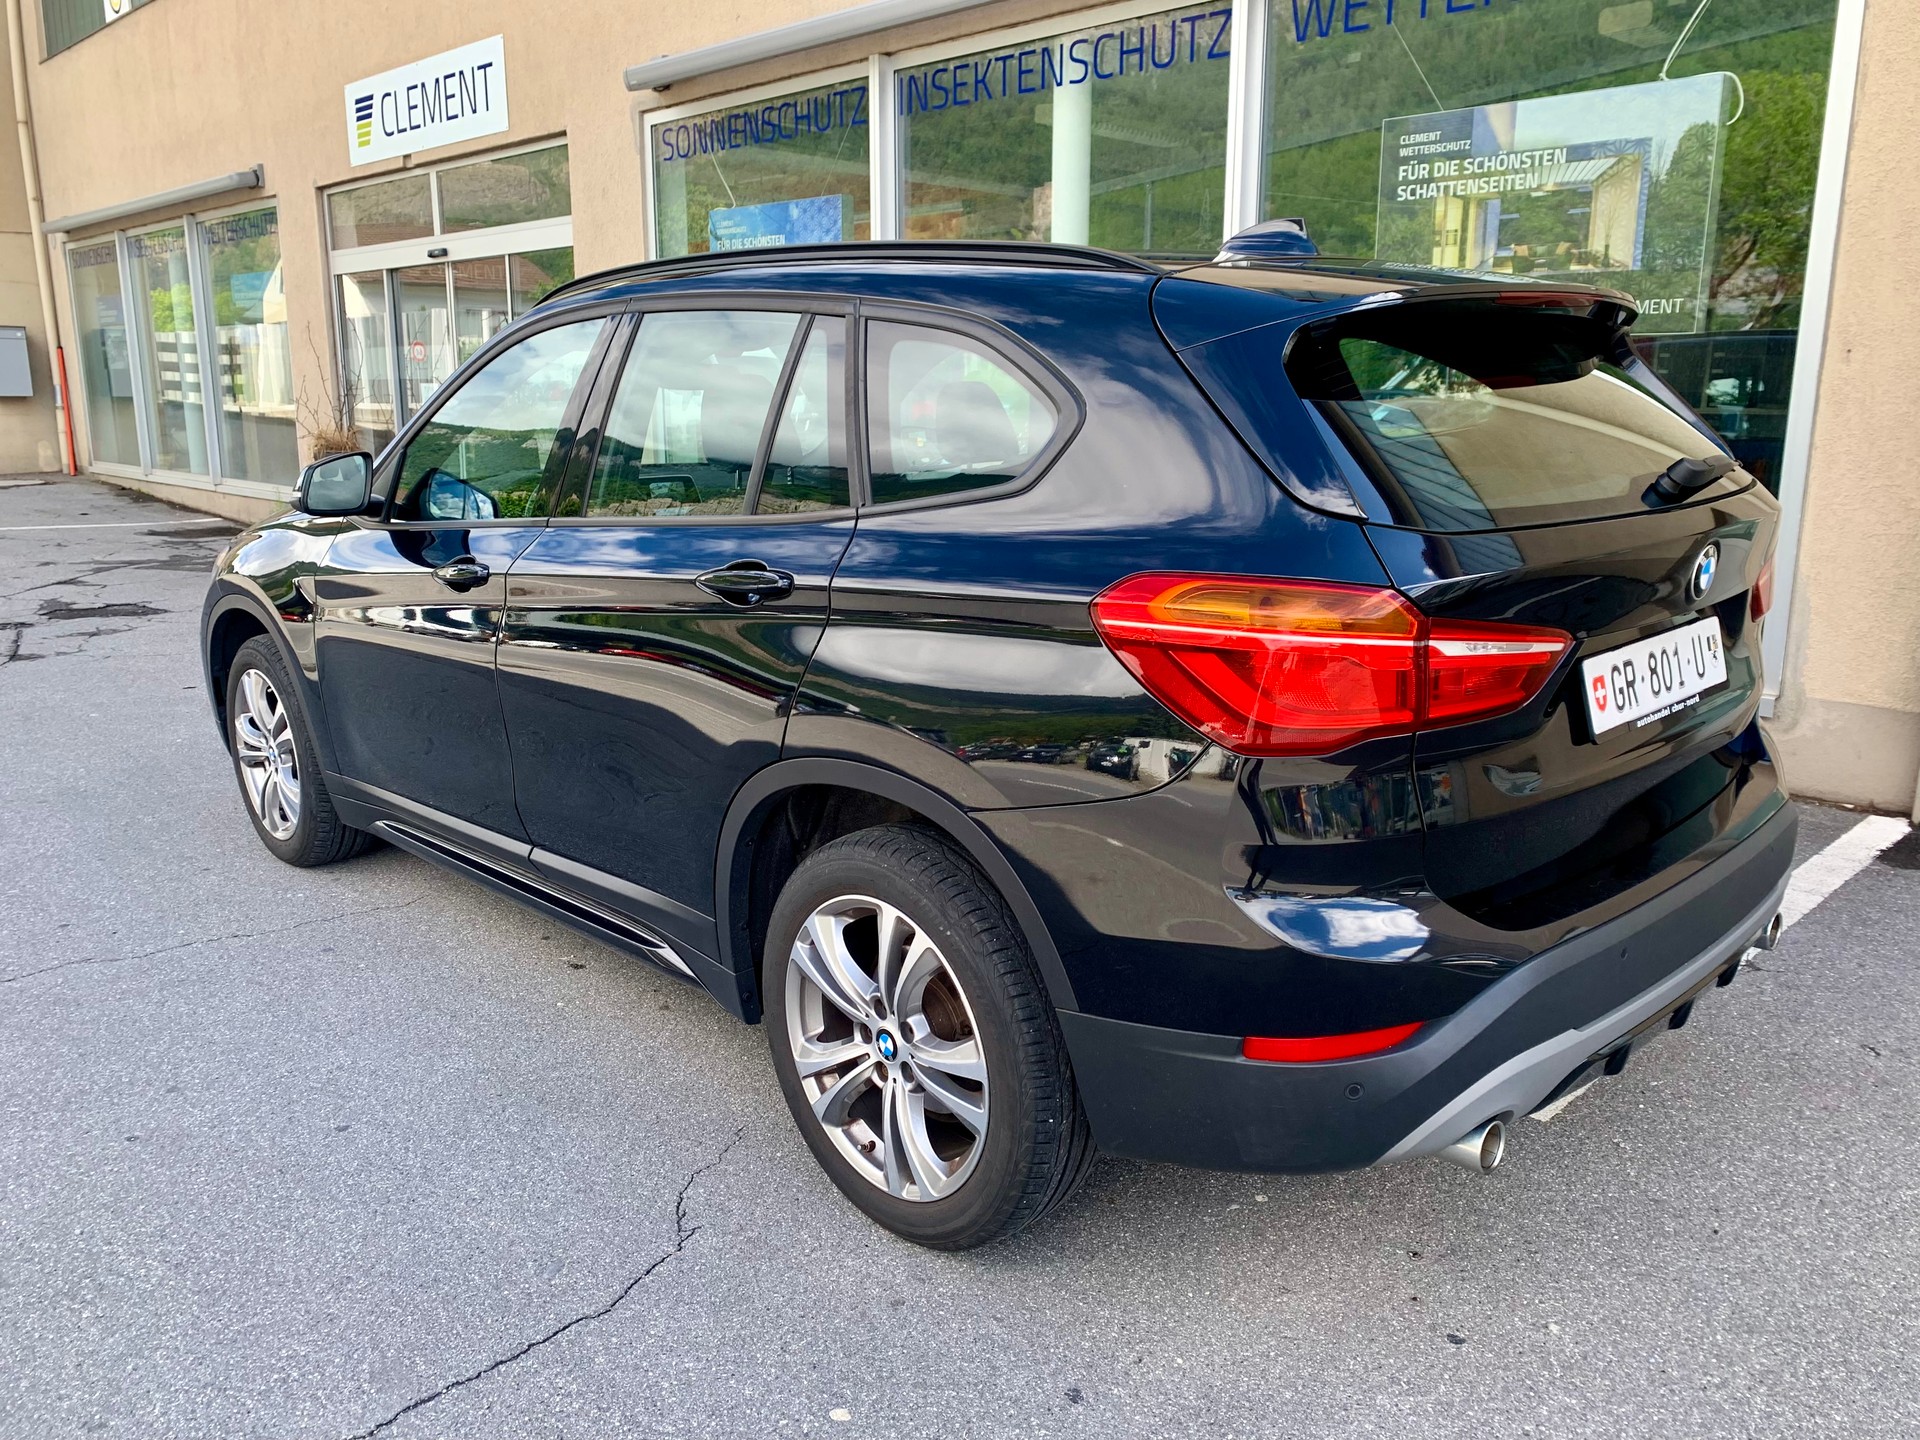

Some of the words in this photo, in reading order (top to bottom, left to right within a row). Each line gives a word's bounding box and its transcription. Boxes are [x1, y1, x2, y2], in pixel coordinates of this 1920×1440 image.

[899, 8, 1232, 116] INSEKTENSCHUTZ
[381, 61, 493, 137] CLEMENT
[662, 86, 867, 161] SONNENSCHUTZ
[1400, 131, 1442, 145] CLEMENT
[1400, 139, 1472, 157] WETTERSCHUTZ
[1398, 161, 1429, 181] FÜR
[1433, 159, 1460, 178] DIE
[1463, 148, 1567, 175] SCHÖNSTEN
[1396, 172, 1539, 201] SCHATTENSEITEN
[717, 237, 731, 251] FÜR
[732, 238, 743, 249] DIE
[744, 234, 785, 248] SCHÖNSTEN
[1636, 298, 1684, 314] MENT
[1636, 706, 1671, 728] autohandel
[1671, 694, 1700, 712] chur-nord
